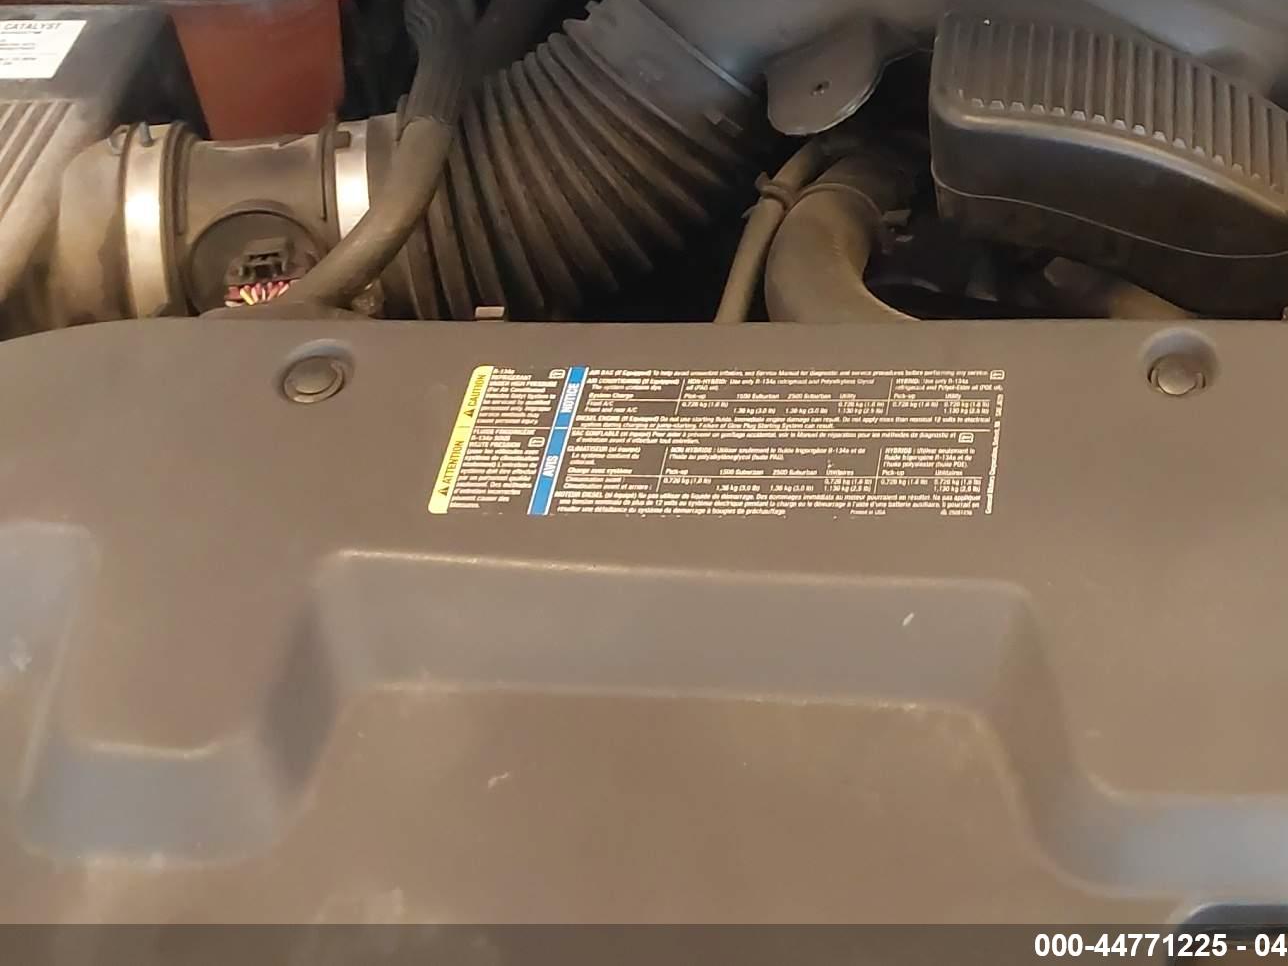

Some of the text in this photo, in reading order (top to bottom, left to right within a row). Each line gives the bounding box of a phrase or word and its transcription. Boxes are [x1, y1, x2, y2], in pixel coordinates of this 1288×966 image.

[4, 22, 62, 30] CATALYST
[467, 374, 487, 407] CAUTION
[561, 382, 582, 414] NOTICE
[855, 401, 863, 409] kg
[910, 401, 918, 409] kg
[443, 440, 464, 484] ATTENTION
[543, 455, 558, 477] AVIS
